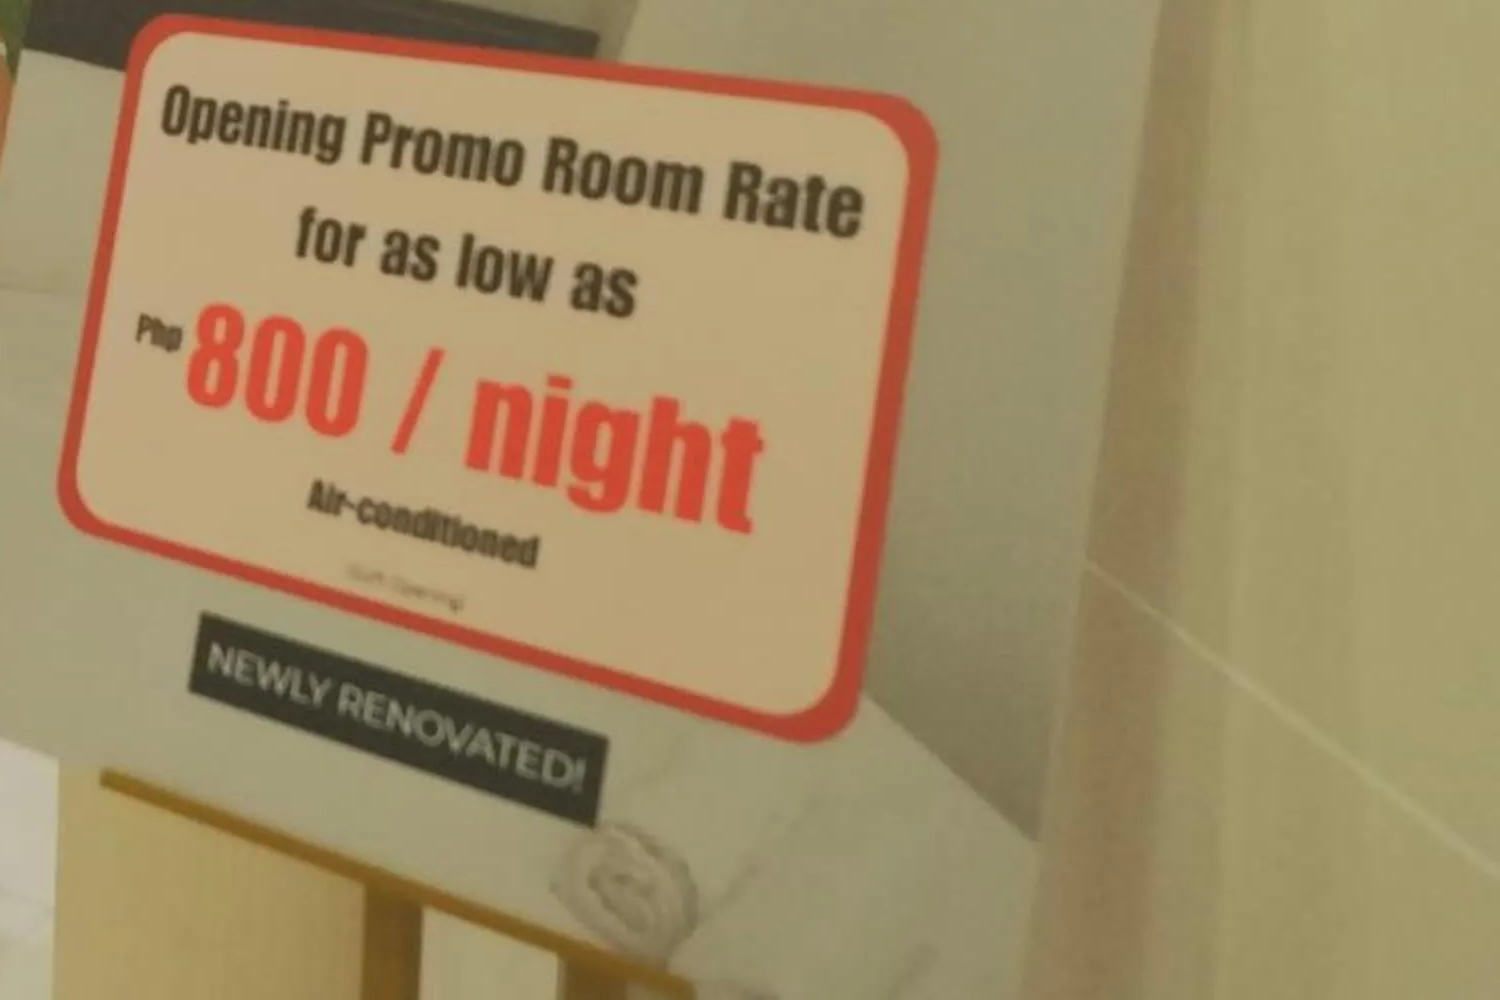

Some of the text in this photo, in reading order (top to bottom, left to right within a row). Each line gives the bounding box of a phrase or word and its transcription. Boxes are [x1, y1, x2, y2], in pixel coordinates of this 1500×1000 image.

[161, 84, 865, 240] Opening Promo Room Rate
[294, 205, 639, 319] for as low as
[136, 313, 183, 353] Php
[186, 304, 369, 437] 800
[464, 374, 766, 535] night
[306, 478, 540, 568] Air-conditioned
[208, 642, 586, 794] NEWLY RENOVATED!
